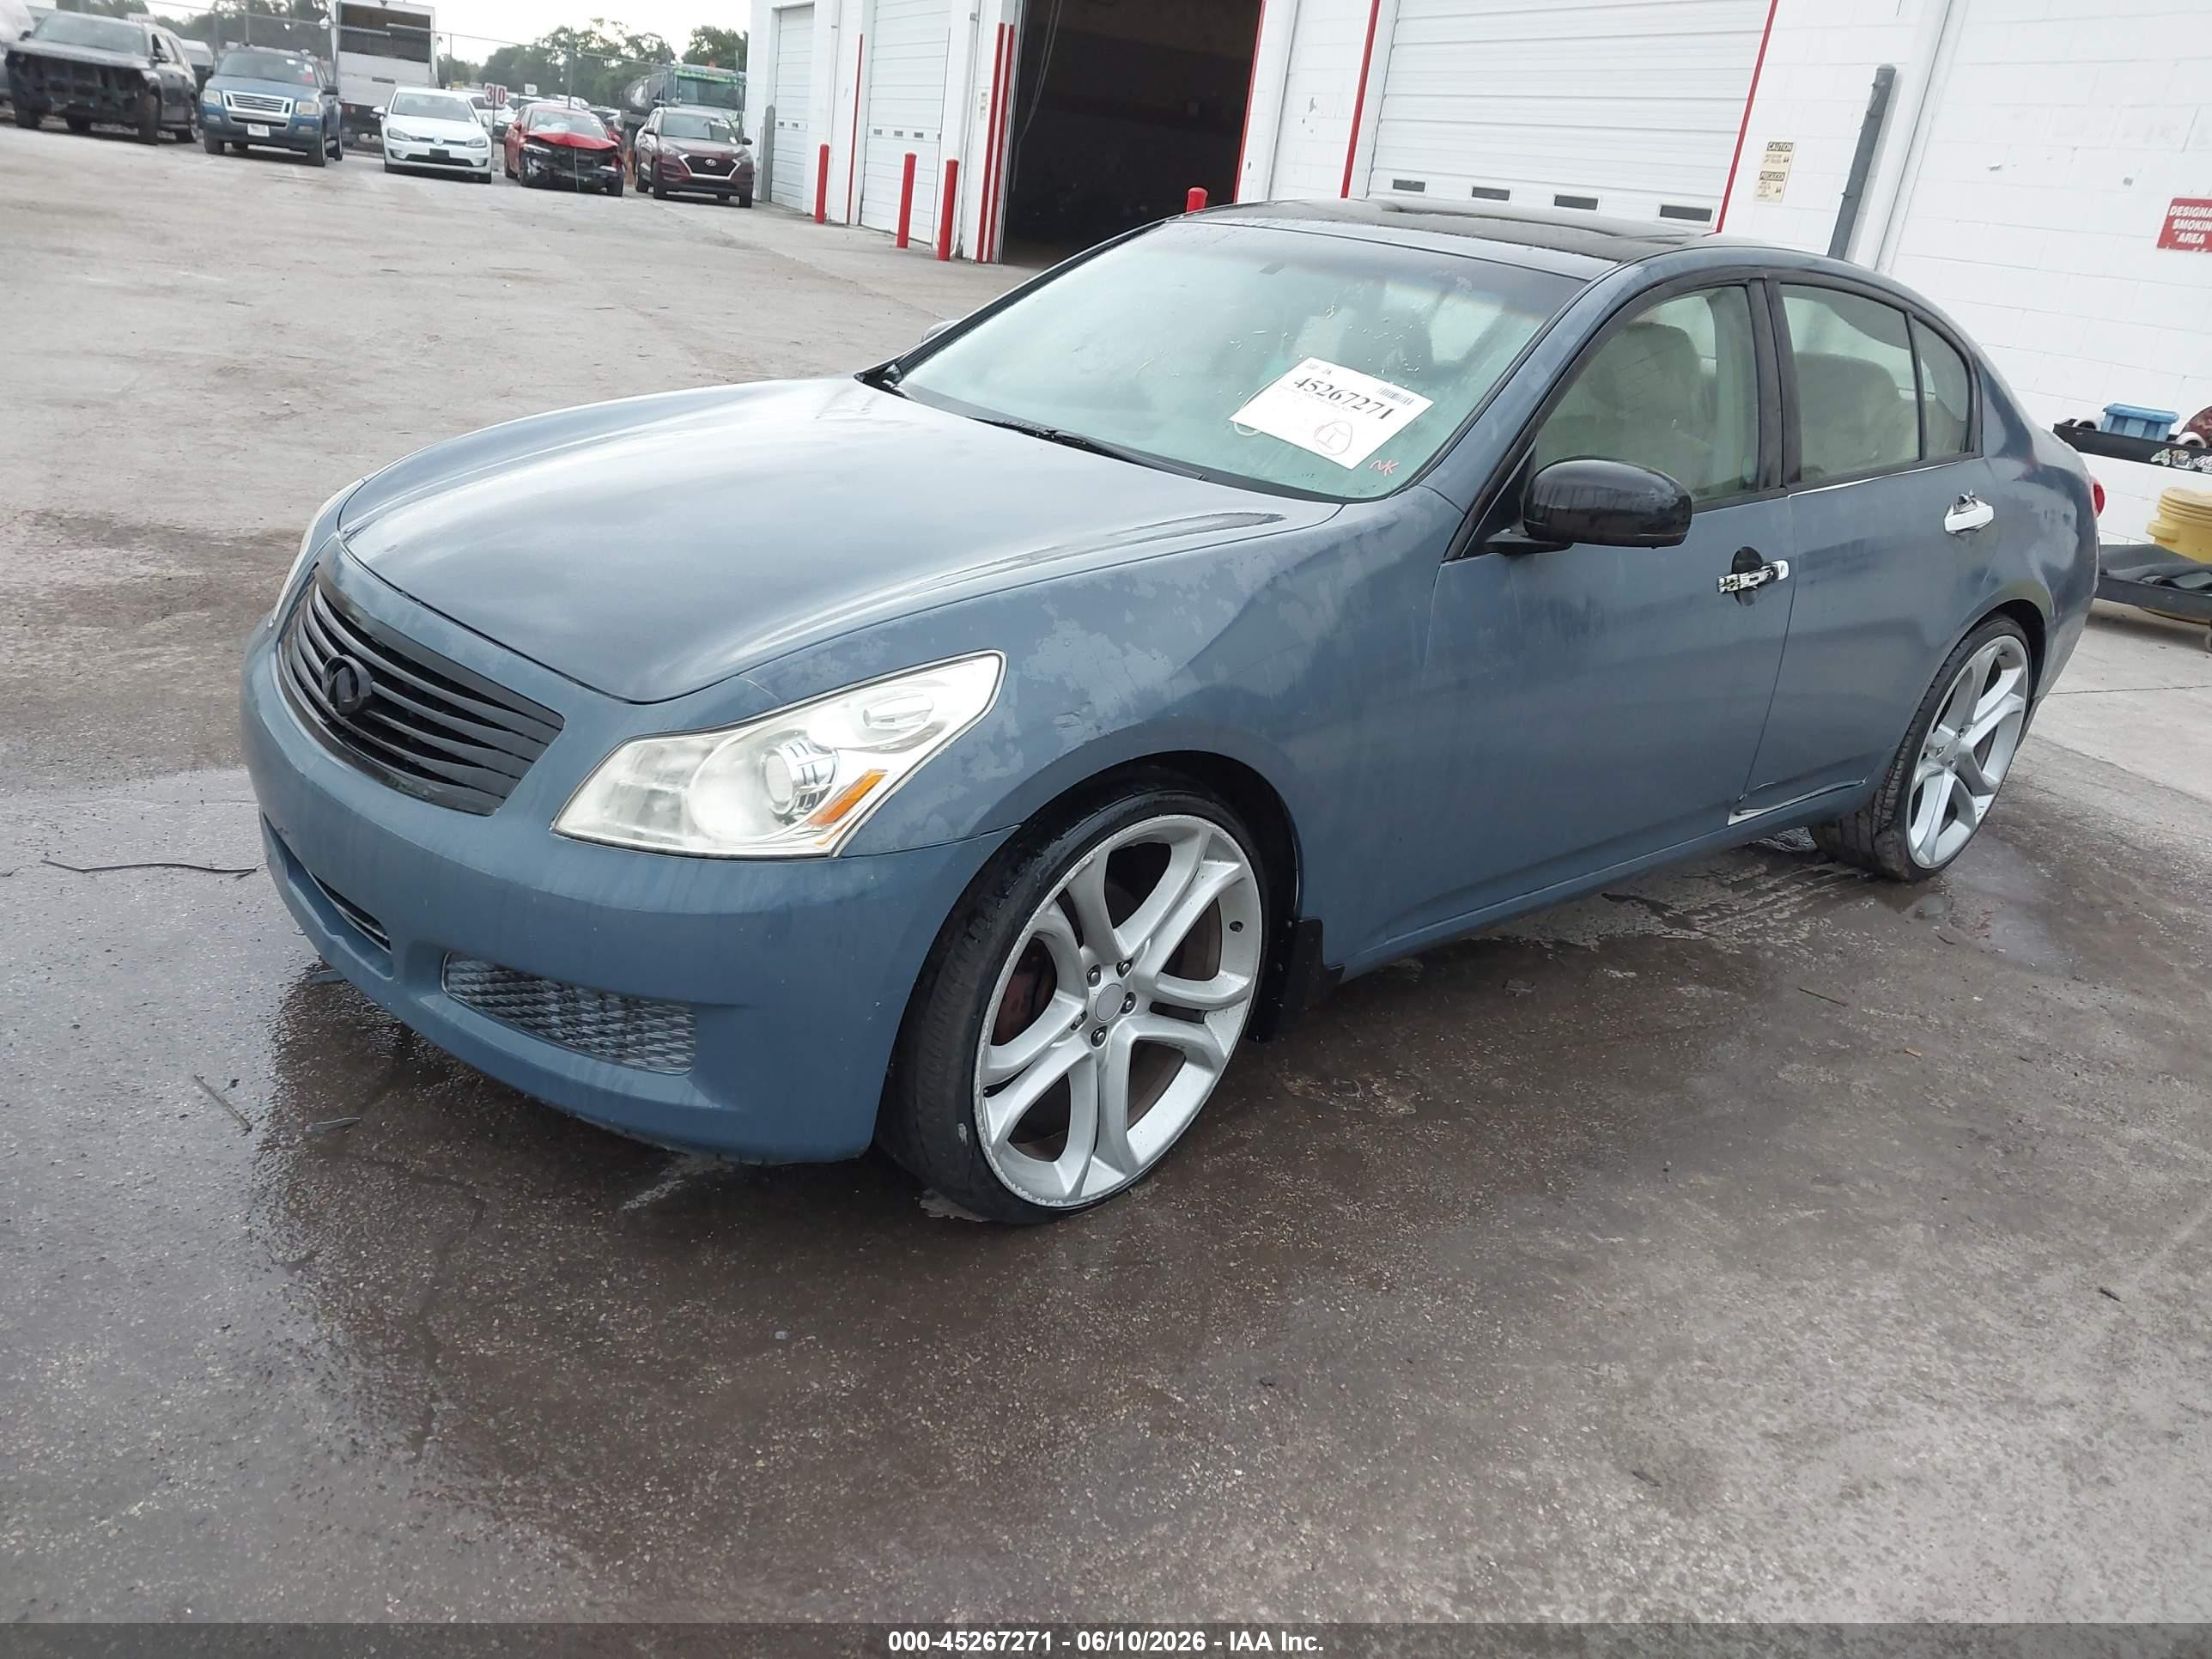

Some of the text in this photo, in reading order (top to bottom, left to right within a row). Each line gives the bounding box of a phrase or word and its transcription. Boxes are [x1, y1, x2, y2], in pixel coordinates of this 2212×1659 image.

[485, 85, 505, 105] 30
[1767, 142, 1793, 151] CAUTION
[2177, 232, 2205, 245] AREA
[1294, 376, 1395, 420] 45267271
